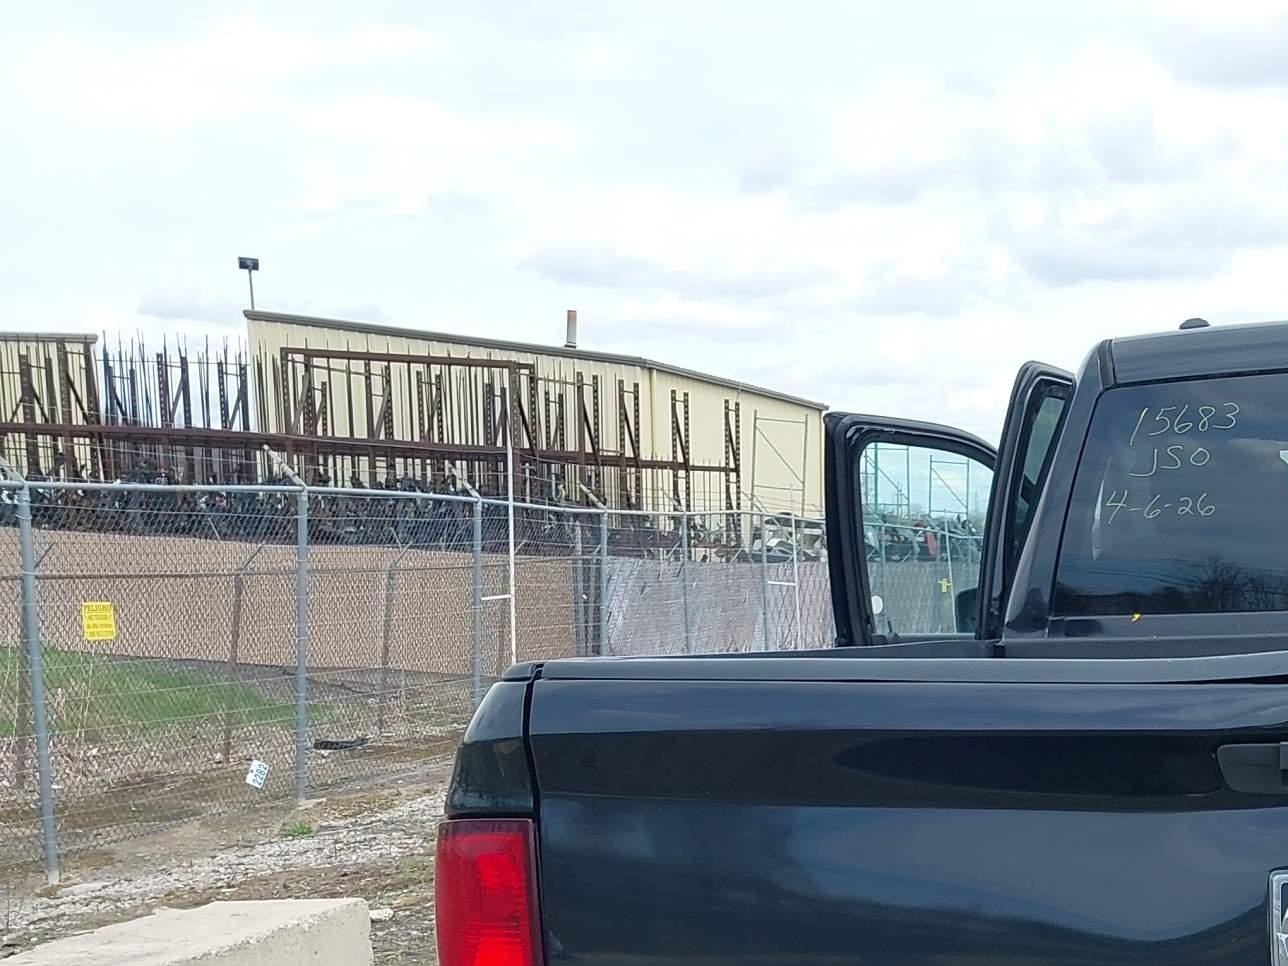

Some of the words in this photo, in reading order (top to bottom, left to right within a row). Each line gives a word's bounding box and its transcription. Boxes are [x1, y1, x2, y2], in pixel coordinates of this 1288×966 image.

[1129, 402, 1240, 445] 15683
[1105, 489, 1216, 524] 4-6-26
[252, 763, 268, 786] 2282
